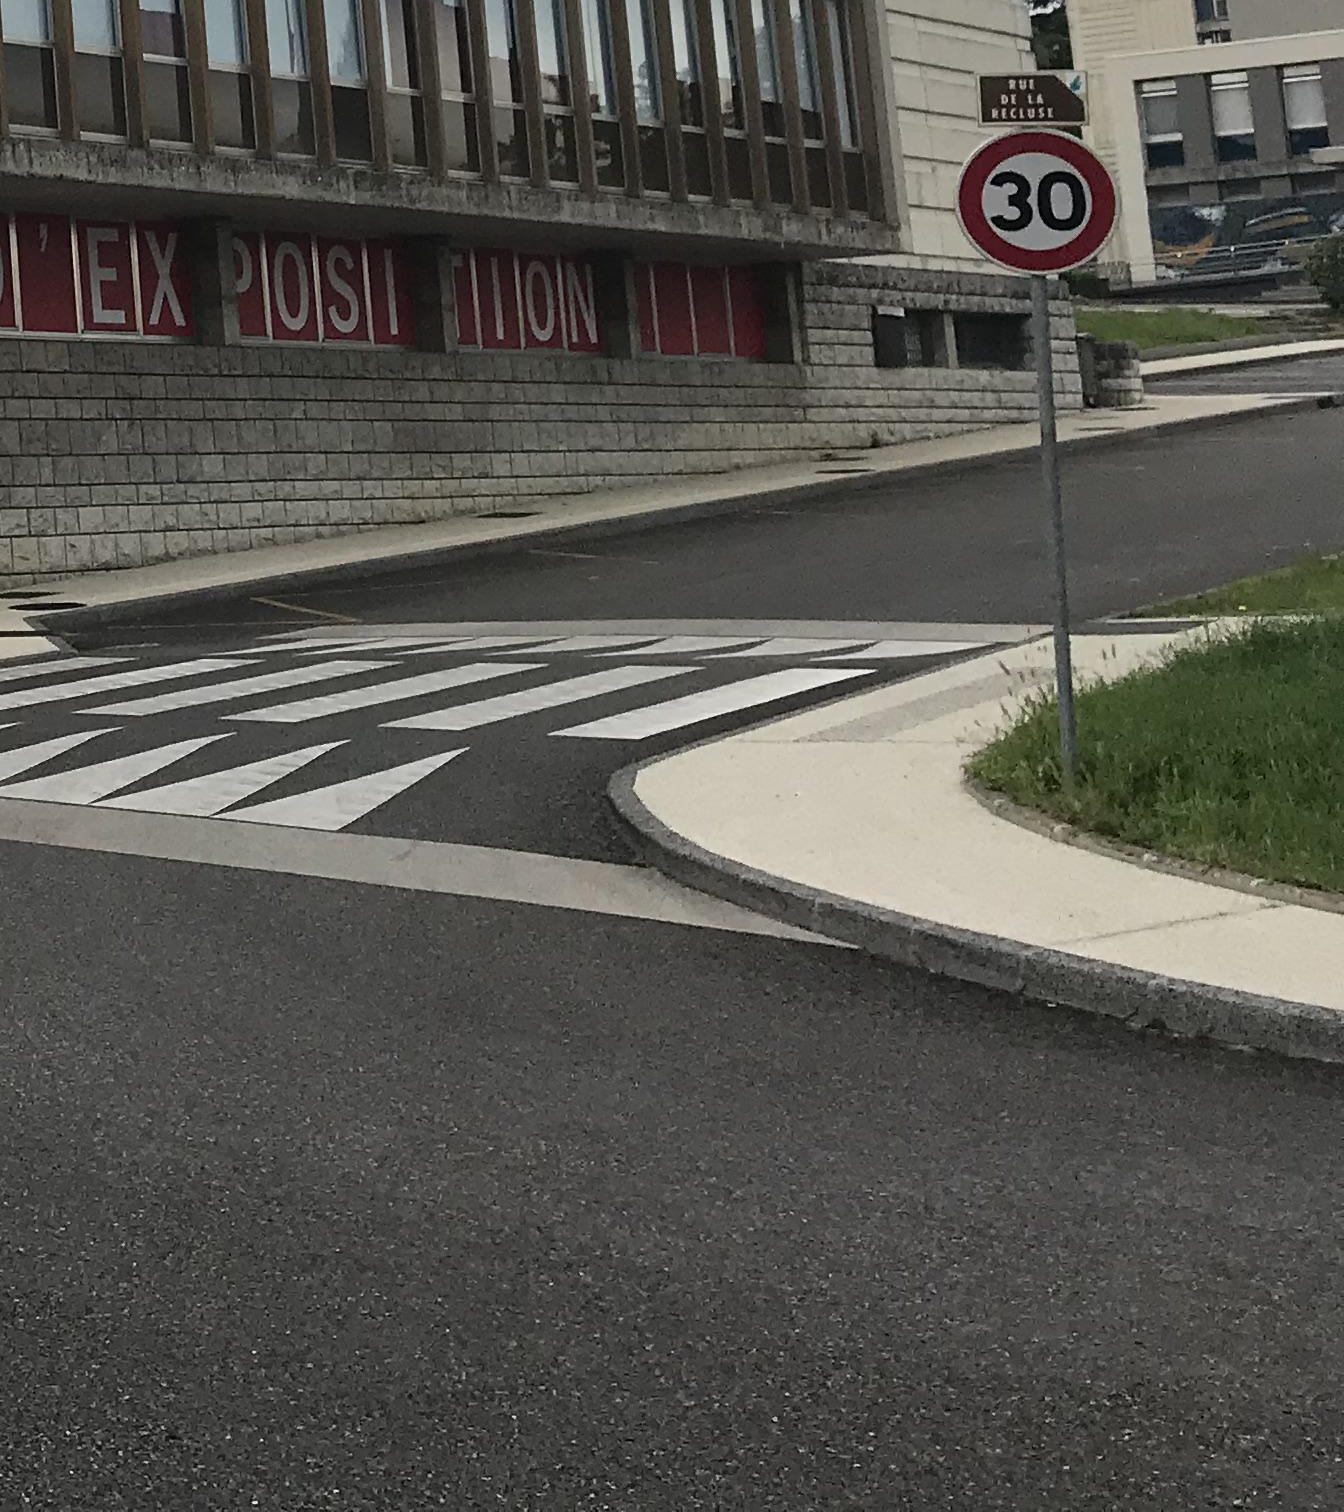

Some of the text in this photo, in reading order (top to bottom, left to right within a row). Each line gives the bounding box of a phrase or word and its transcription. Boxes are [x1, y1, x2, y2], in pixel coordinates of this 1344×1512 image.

[1009, 79, 1035, 90] RUE
[1001, 94, 1044, 105] DE LA
[991, 108, 1055, 119] RECLUSE
[989, 170, 1087, 232] 30
